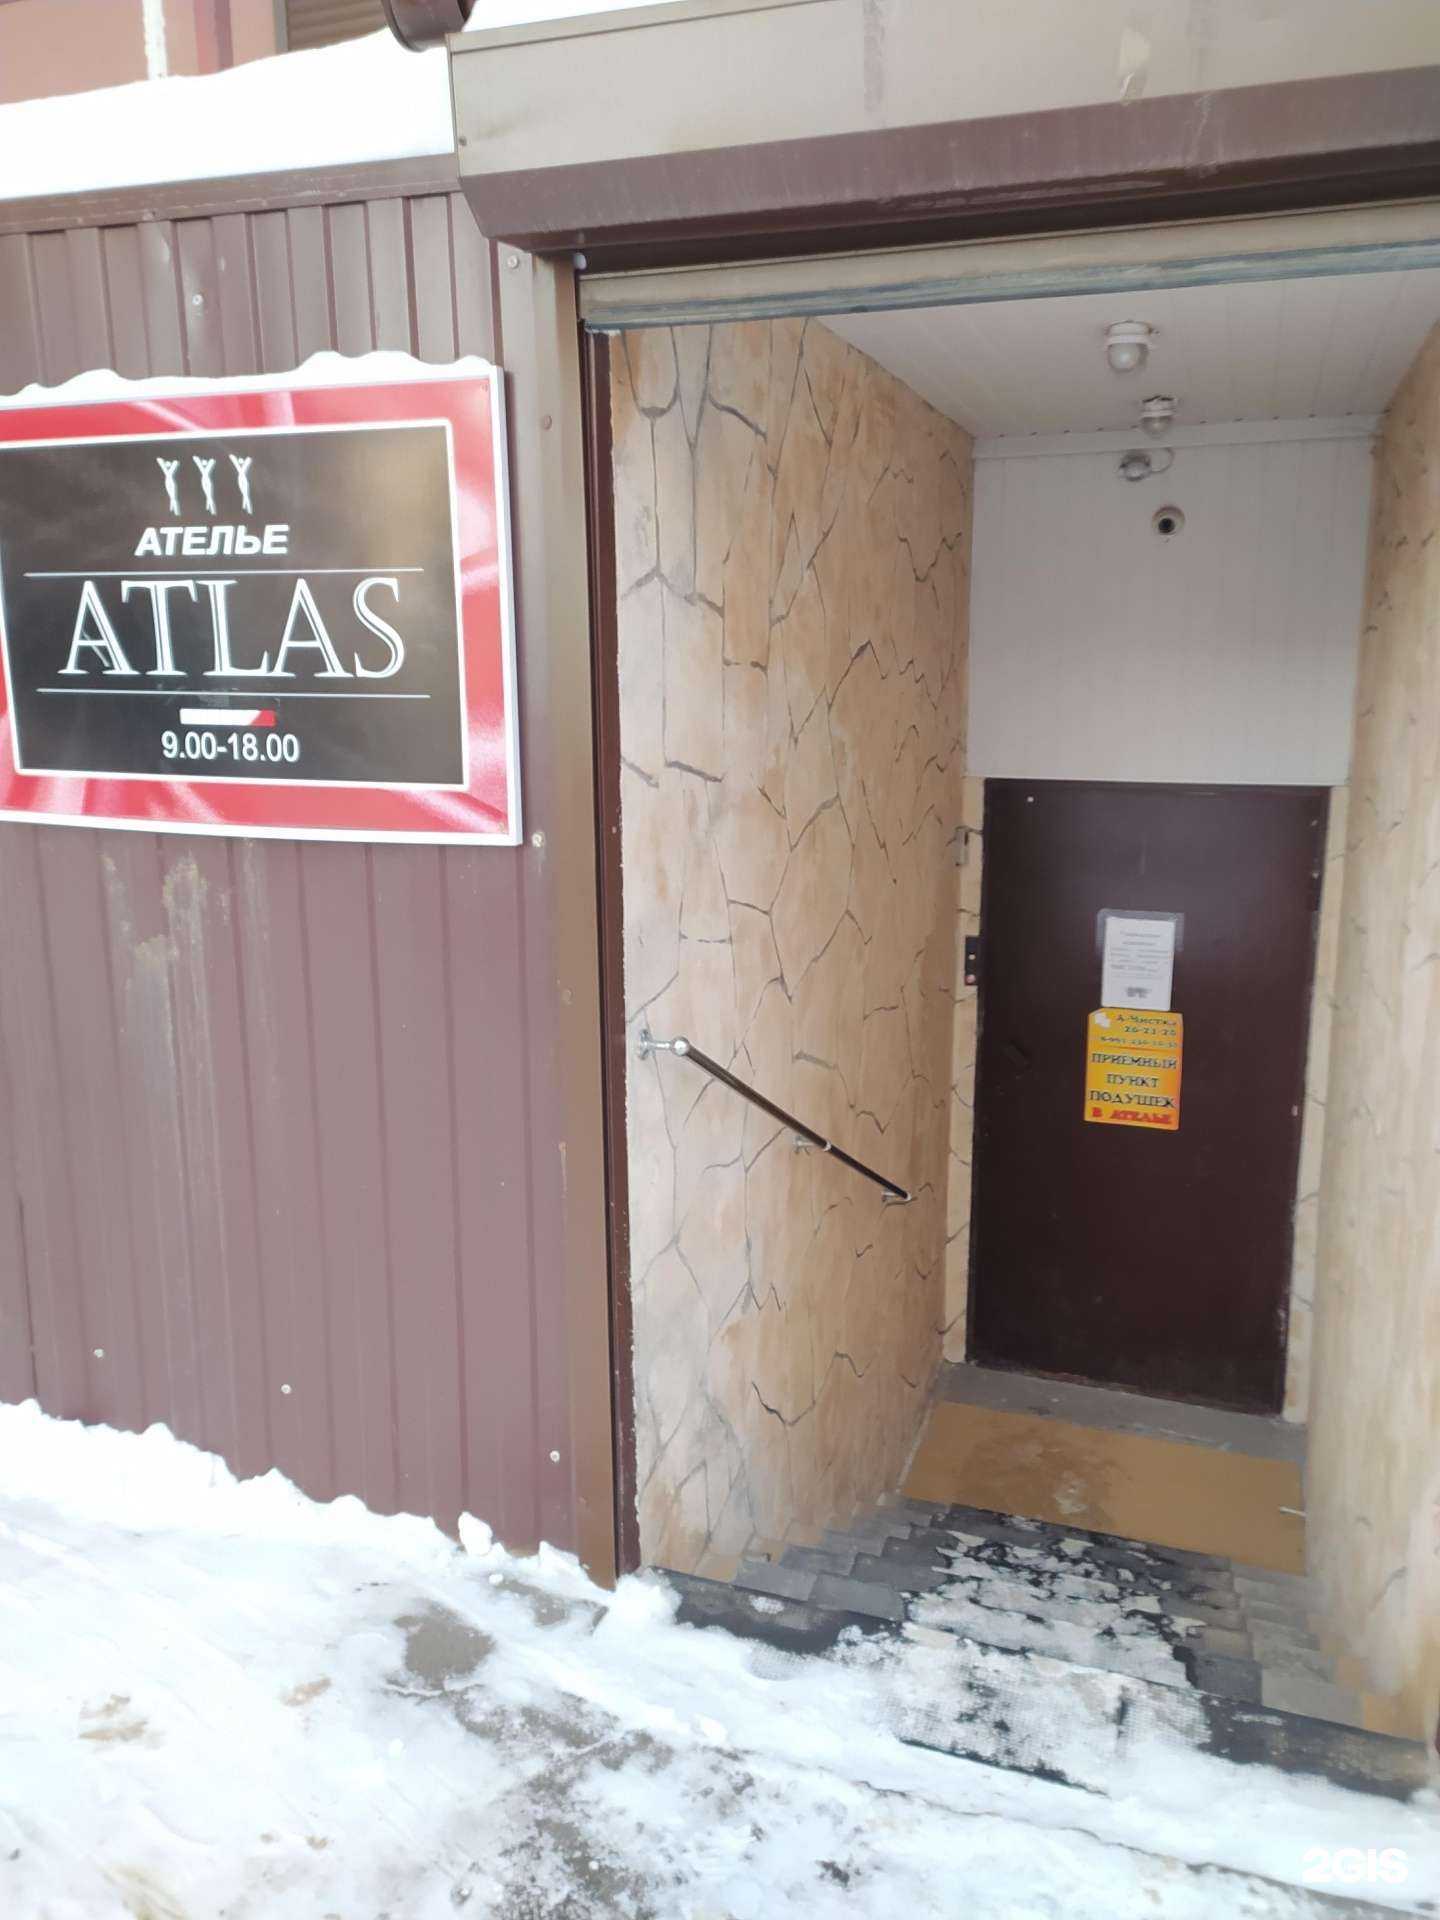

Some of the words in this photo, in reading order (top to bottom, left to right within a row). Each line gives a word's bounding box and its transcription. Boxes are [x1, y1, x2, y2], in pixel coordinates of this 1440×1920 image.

[134, 525, 290, 557] АТЕЛЬЕ
[57, 577, 405, 680] ATLAS
[161, 731, 301, 763] 9.00-18.00
[1107, 1073, 1159, 1087] ПУНКТ
[1089, 1091, 1175, 1108] ПОДУШЕК
